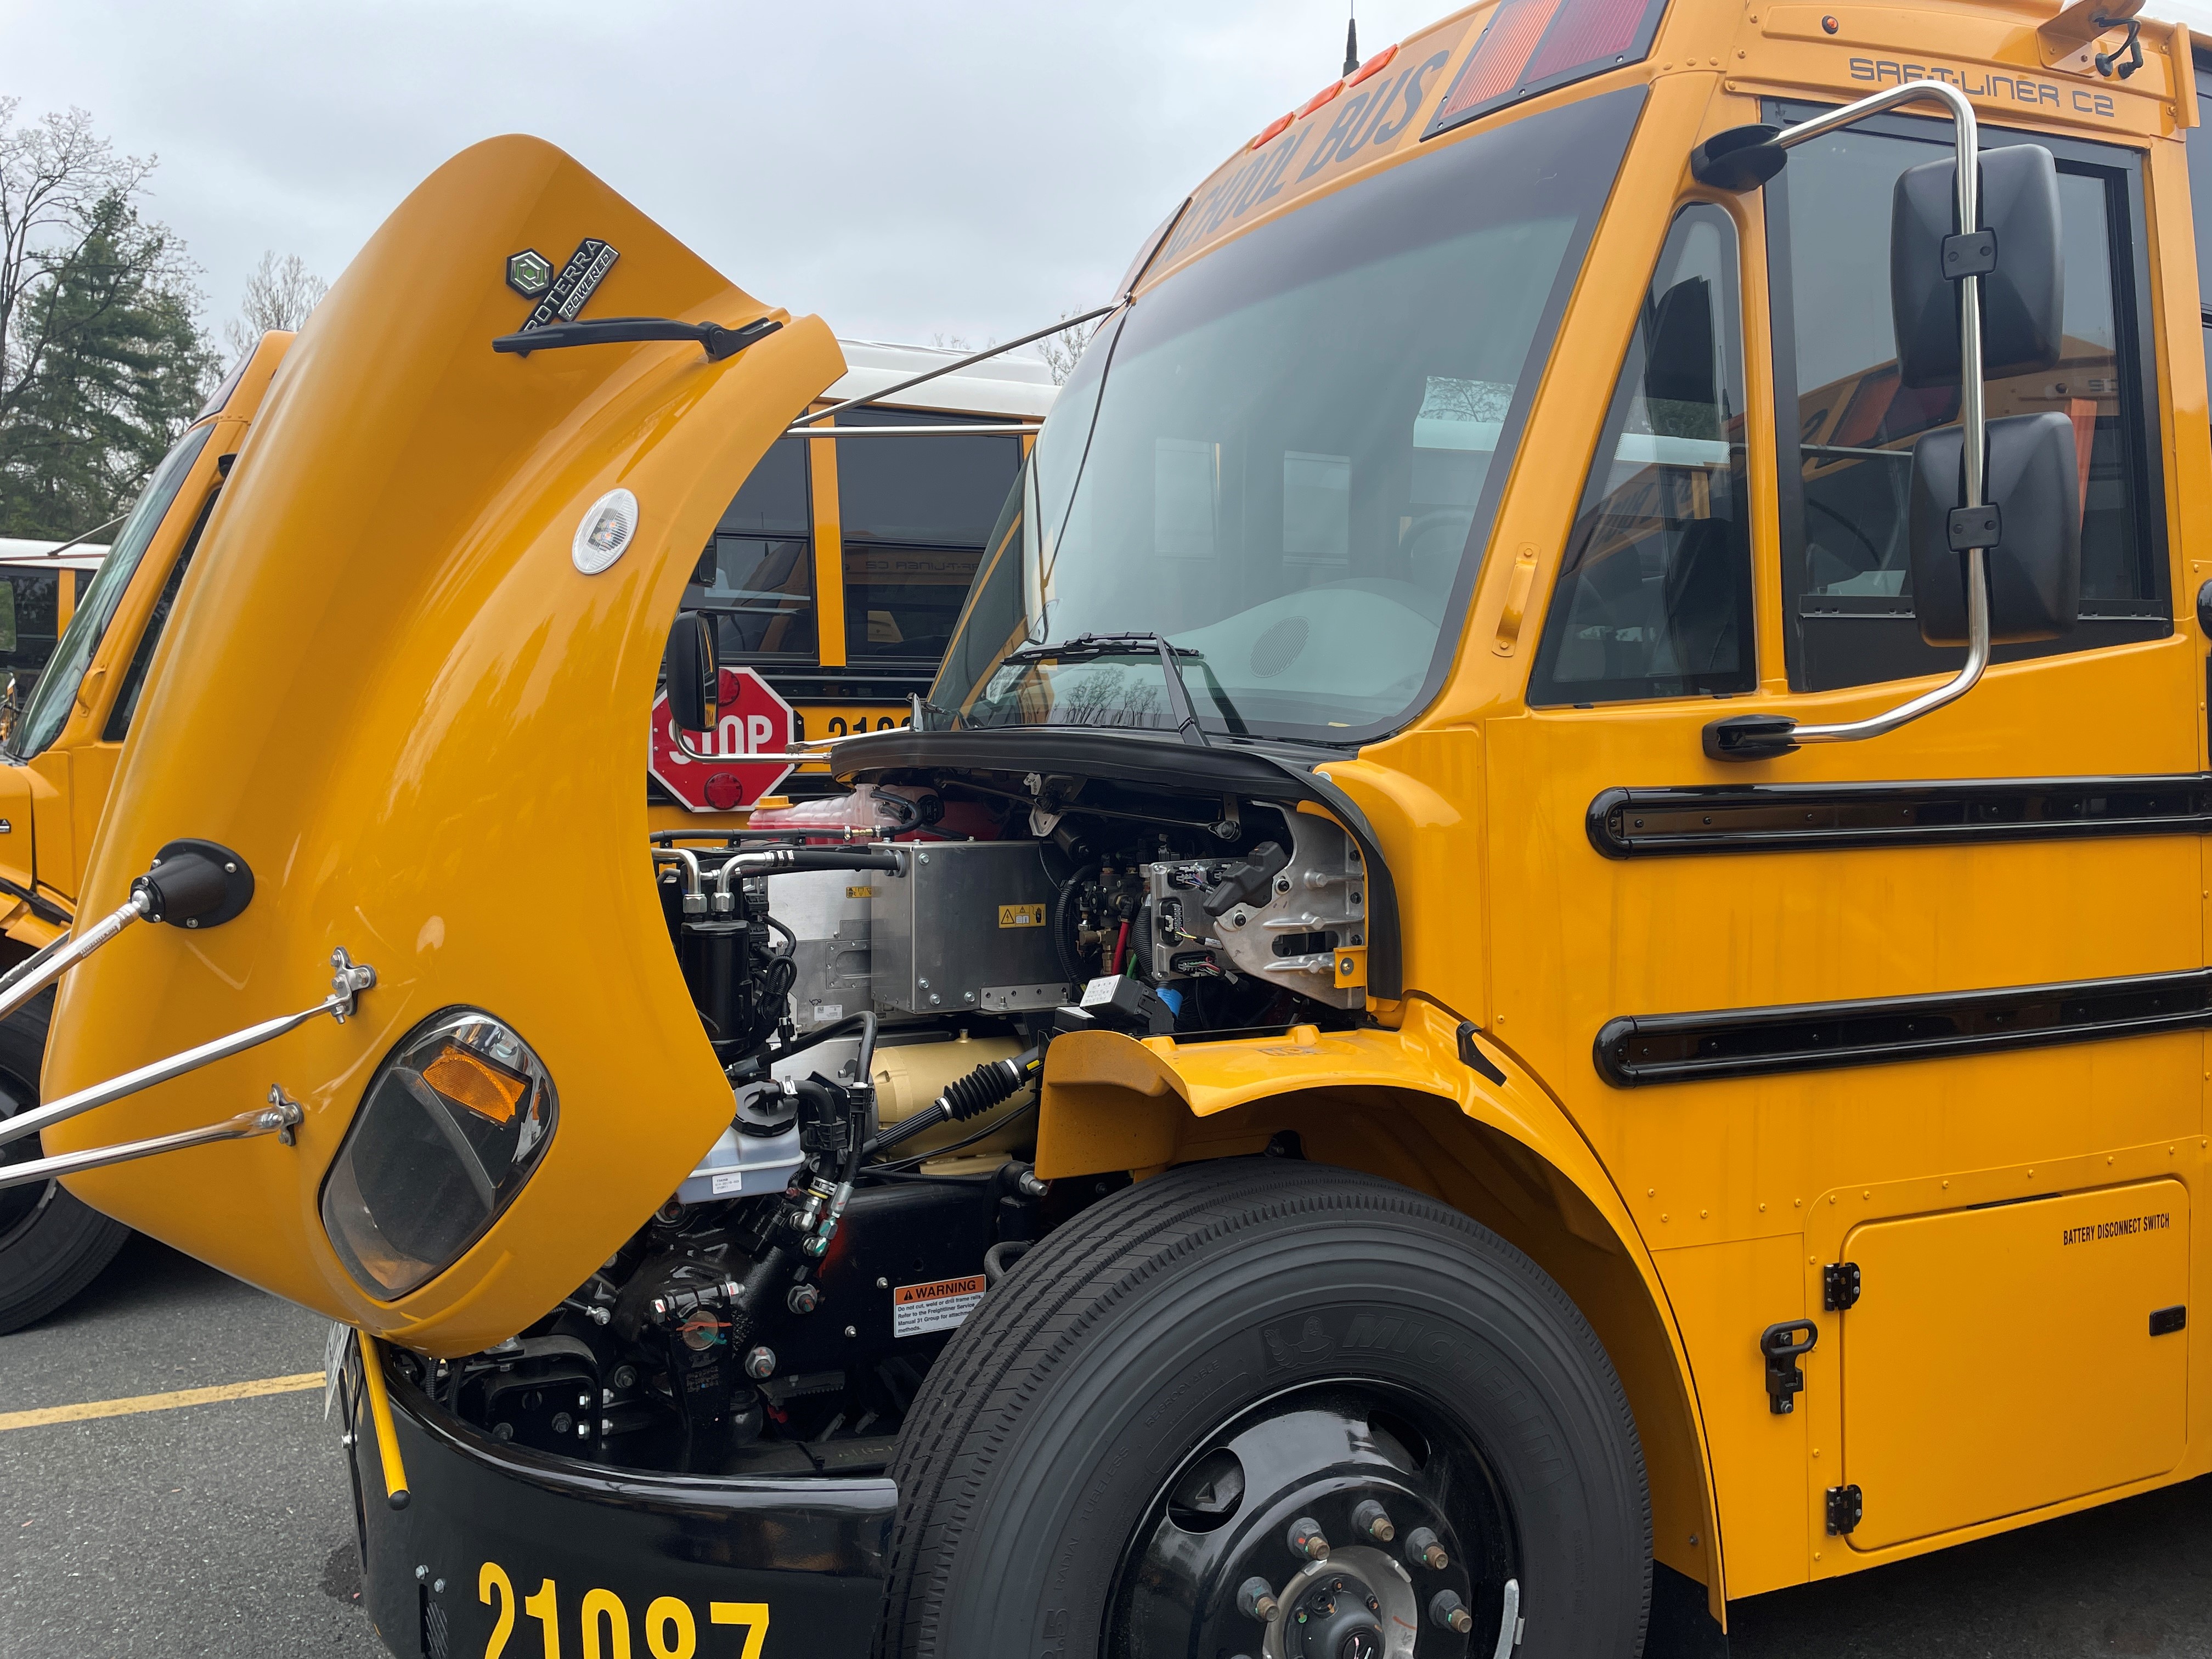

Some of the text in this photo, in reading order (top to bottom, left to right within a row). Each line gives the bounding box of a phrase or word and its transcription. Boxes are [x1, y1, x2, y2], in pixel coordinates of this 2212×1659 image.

[2072, 90, 2115, 117] C2
[1148, 49, 1450, 275] SCHOOL BUS
[563, 253, 611, 318] POWERED
[2063, 1212, 2170, 1246] BATTERY DISCONNECT SWITCH
[916, 1280, 976, 1299] WARNING
[924, 1314, 940, 1323] Group
[928, 1306, 956, 1314] Freightliner
[1341, 1314, 1573, 1493] MICHELIN
[478, 1561, 769, 1659] 21087
